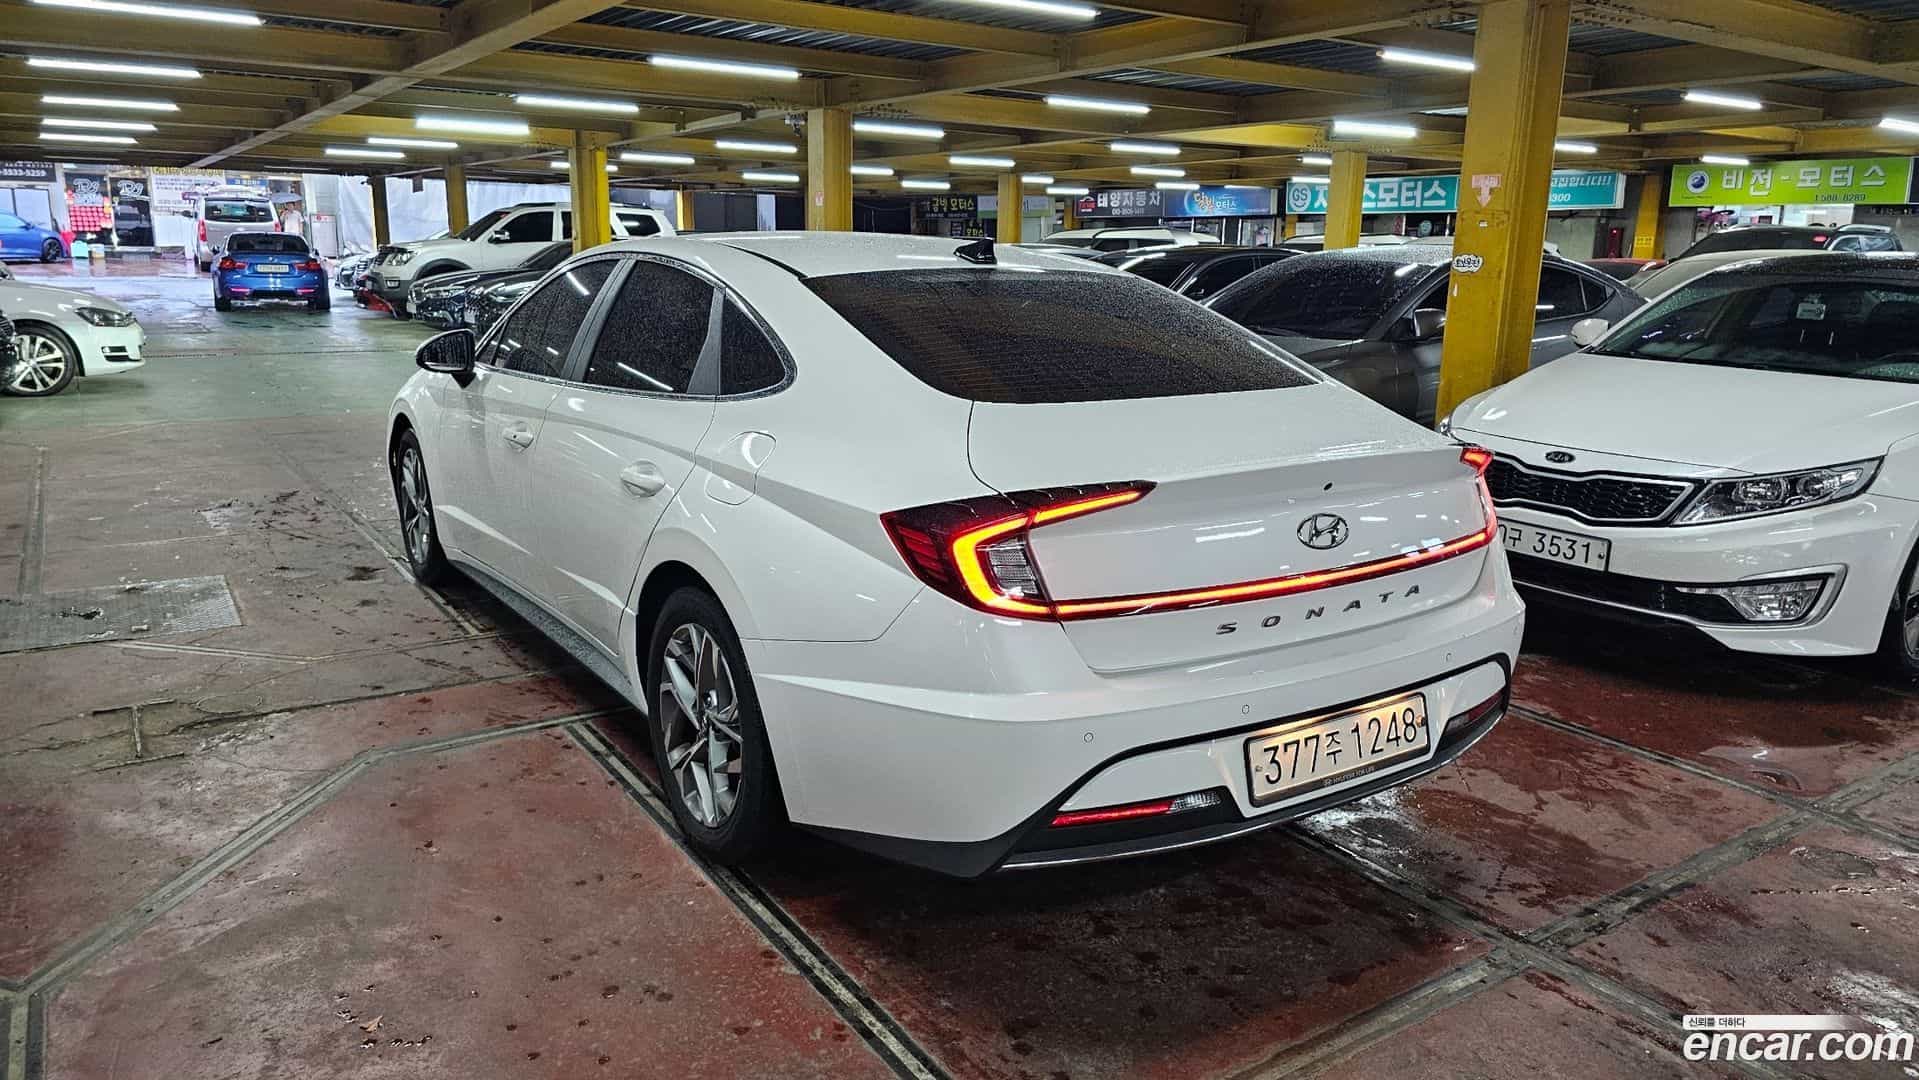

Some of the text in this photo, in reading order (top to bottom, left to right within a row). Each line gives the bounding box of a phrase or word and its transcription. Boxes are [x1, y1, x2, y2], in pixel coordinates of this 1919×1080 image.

[1292, 187, 1308, 202] GS
[1721, 165, 1886, 197] 비전-모터스
[950, 197, 976, 211] 모터스
[1097, 191, 1161, 208] 태양자동차
[1532, 531, 1591, 564] 3531
[1216, 584, 1421, 635] SONATA
[1263, 707, 1418, 785] 377주 1248
